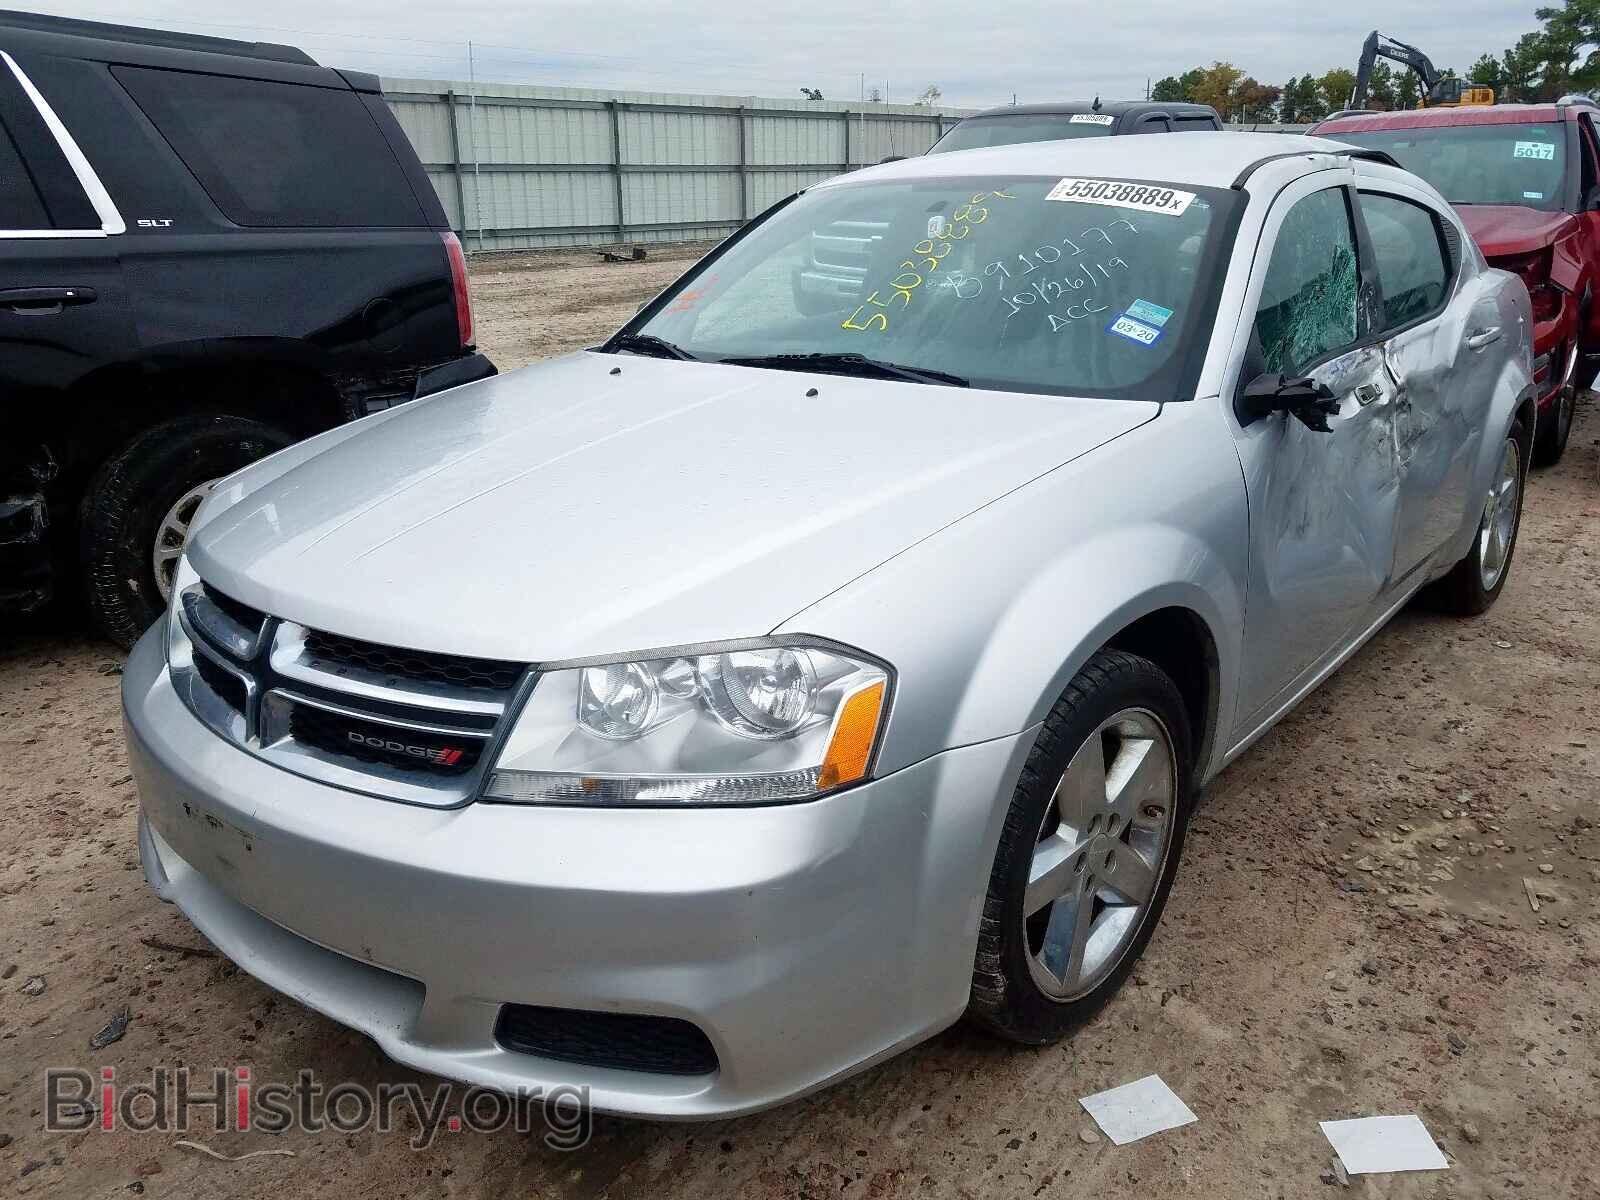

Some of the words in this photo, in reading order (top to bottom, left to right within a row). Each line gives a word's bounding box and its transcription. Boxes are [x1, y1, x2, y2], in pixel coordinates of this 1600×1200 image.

[1517, 147, 1551, 159] 5017
[137, 219, 173, 227] SLT
[1047, 298, 1112, 332] ACC
[347, 731, 447, 763] DODGE
